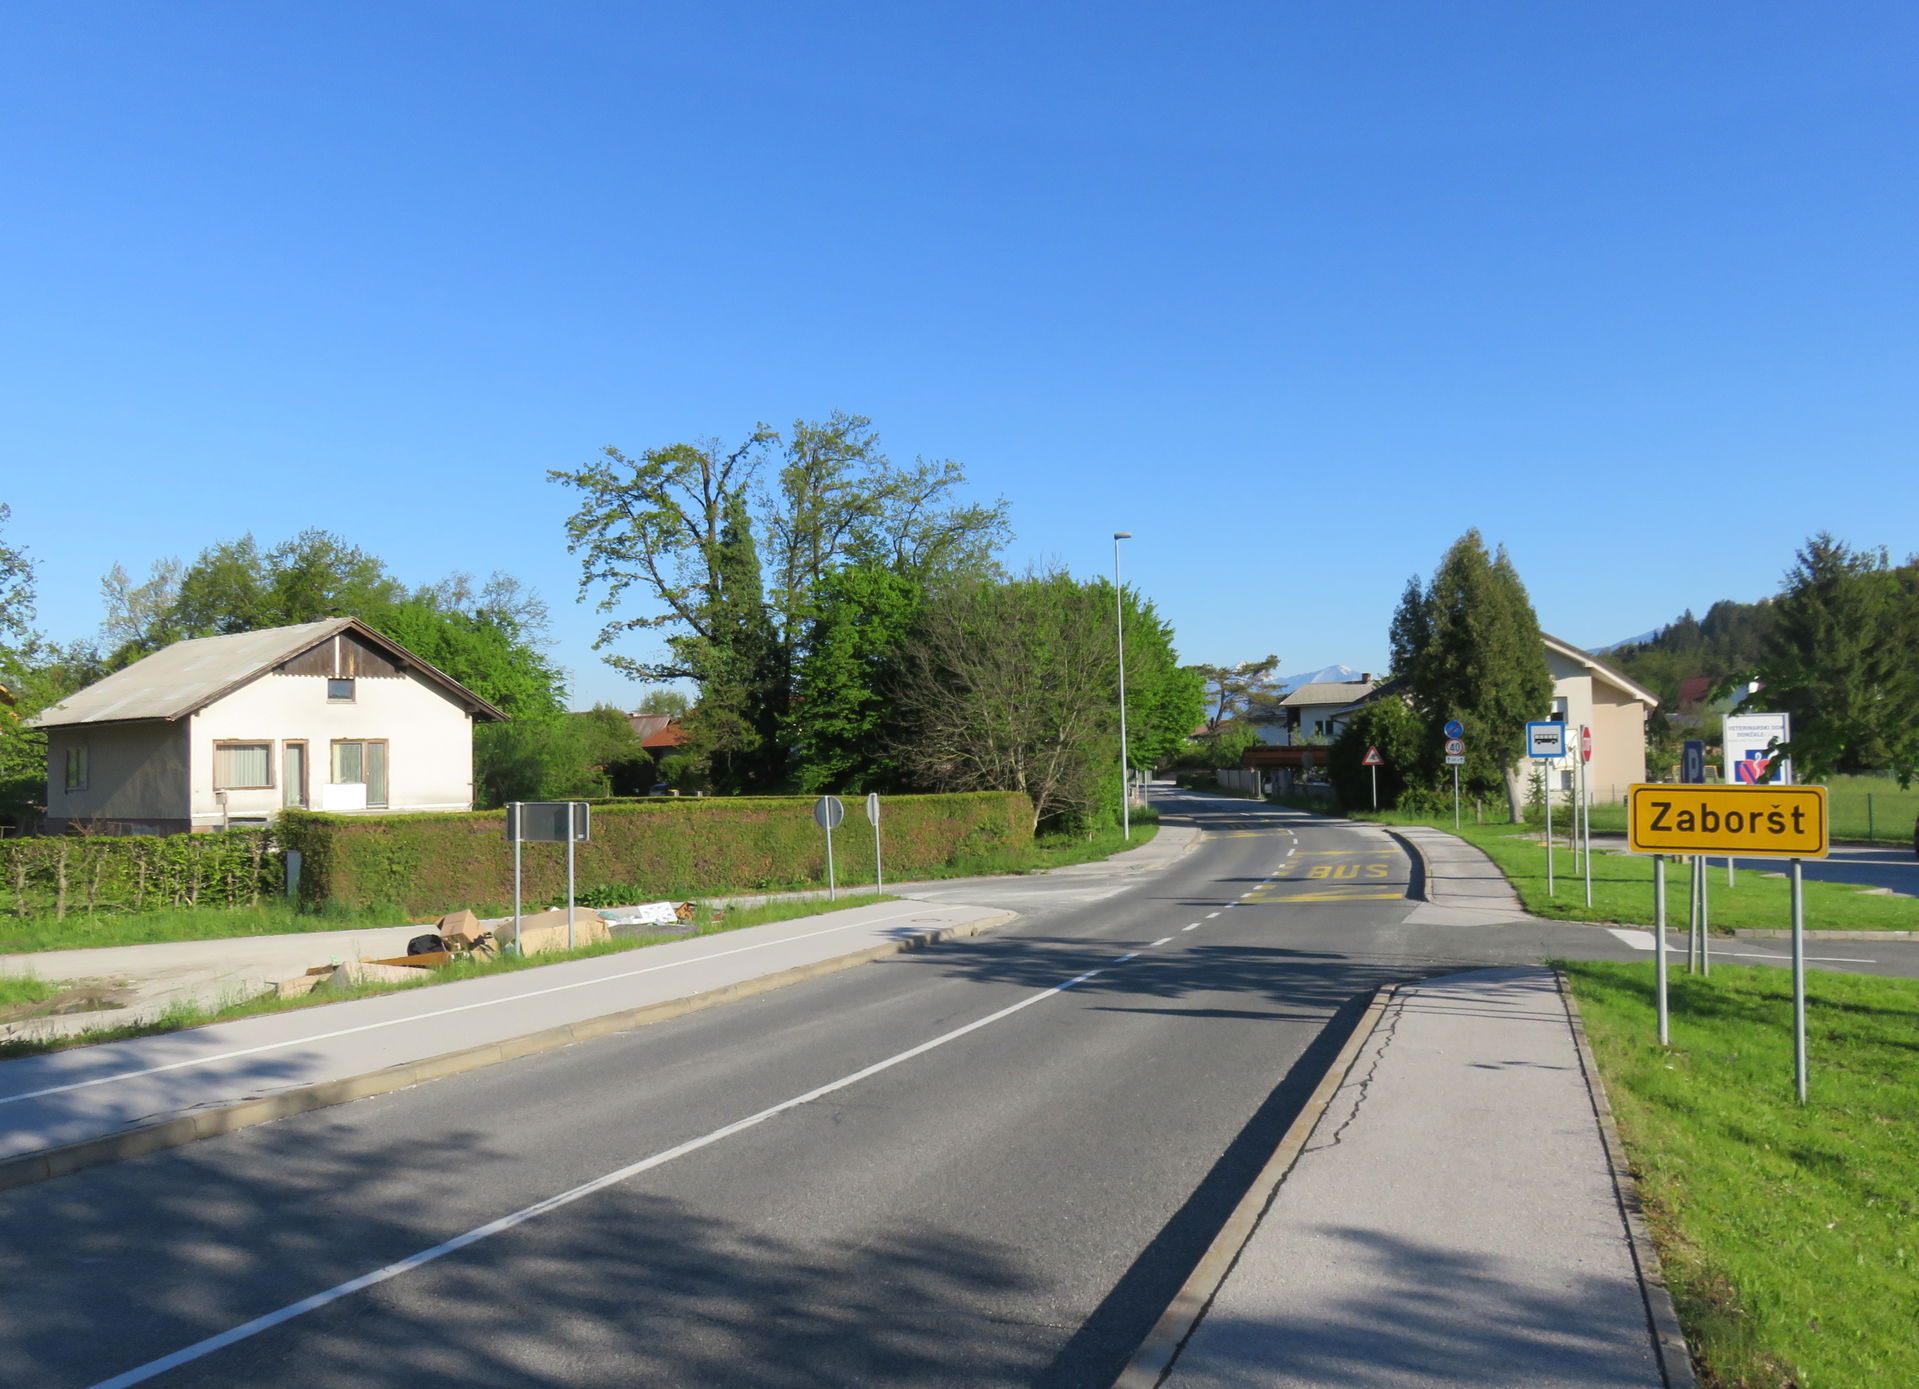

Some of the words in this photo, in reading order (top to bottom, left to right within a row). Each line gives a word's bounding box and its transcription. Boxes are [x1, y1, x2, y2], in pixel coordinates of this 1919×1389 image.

[1450, 742, 1460, 752] 40
[1650, 802, 1805, 834] Zaboršt
[1306, 864, 1389, 879] BUS
